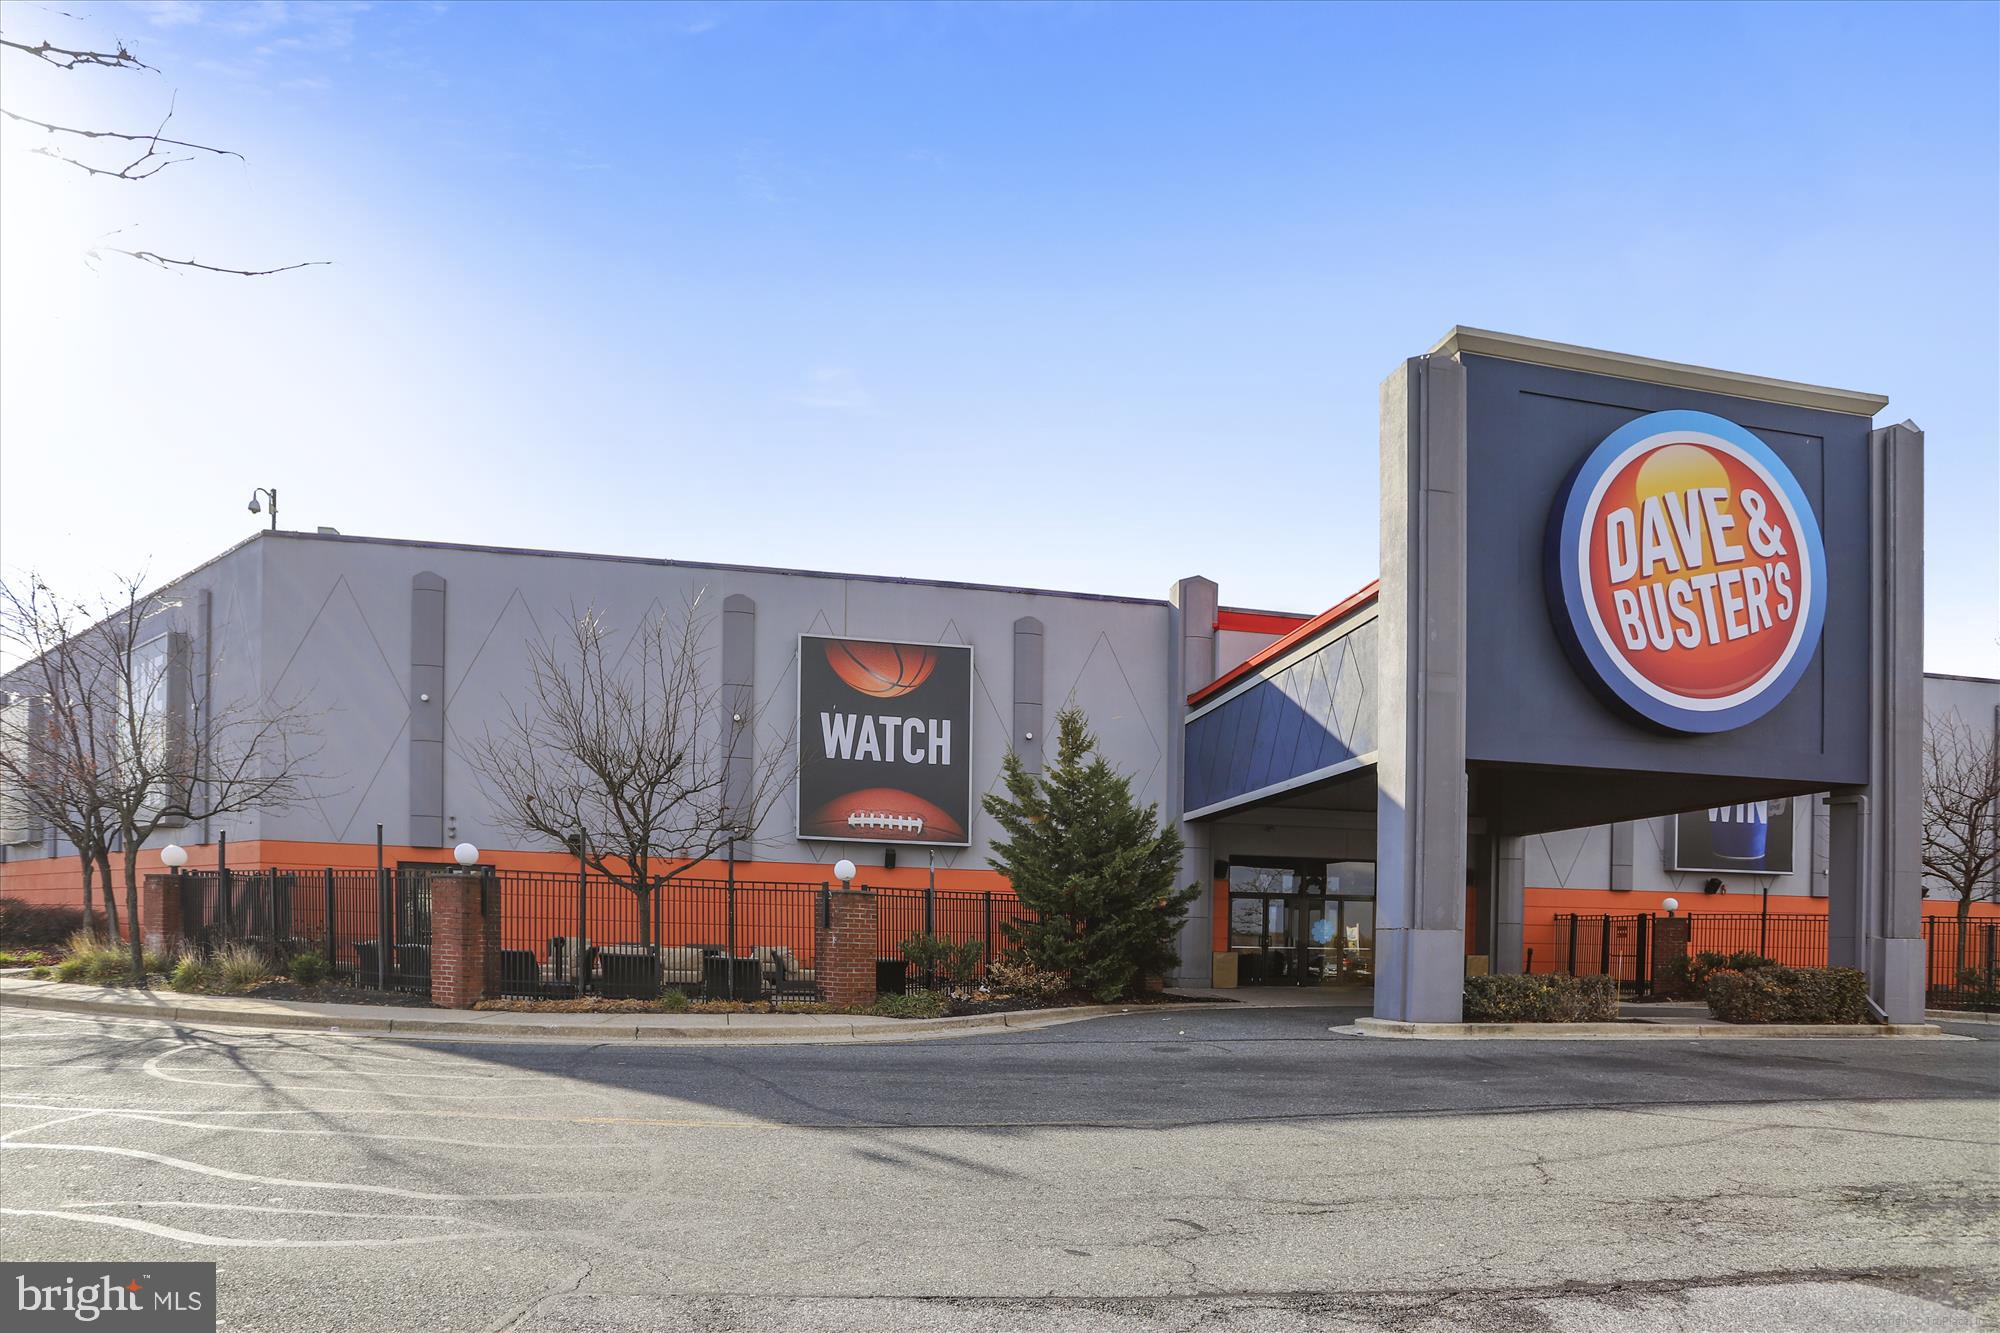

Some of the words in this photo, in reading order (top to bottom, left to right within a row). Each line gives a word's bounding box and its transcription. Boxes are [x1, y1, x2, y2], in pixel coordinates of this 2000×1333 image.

[1607, 488, 1745, 583] DAVE
[1740, 489, 1787, 558] &
[1613, 562, 1794, 651] BUSTER'S
[820, 712, 951, 765] WATCH
